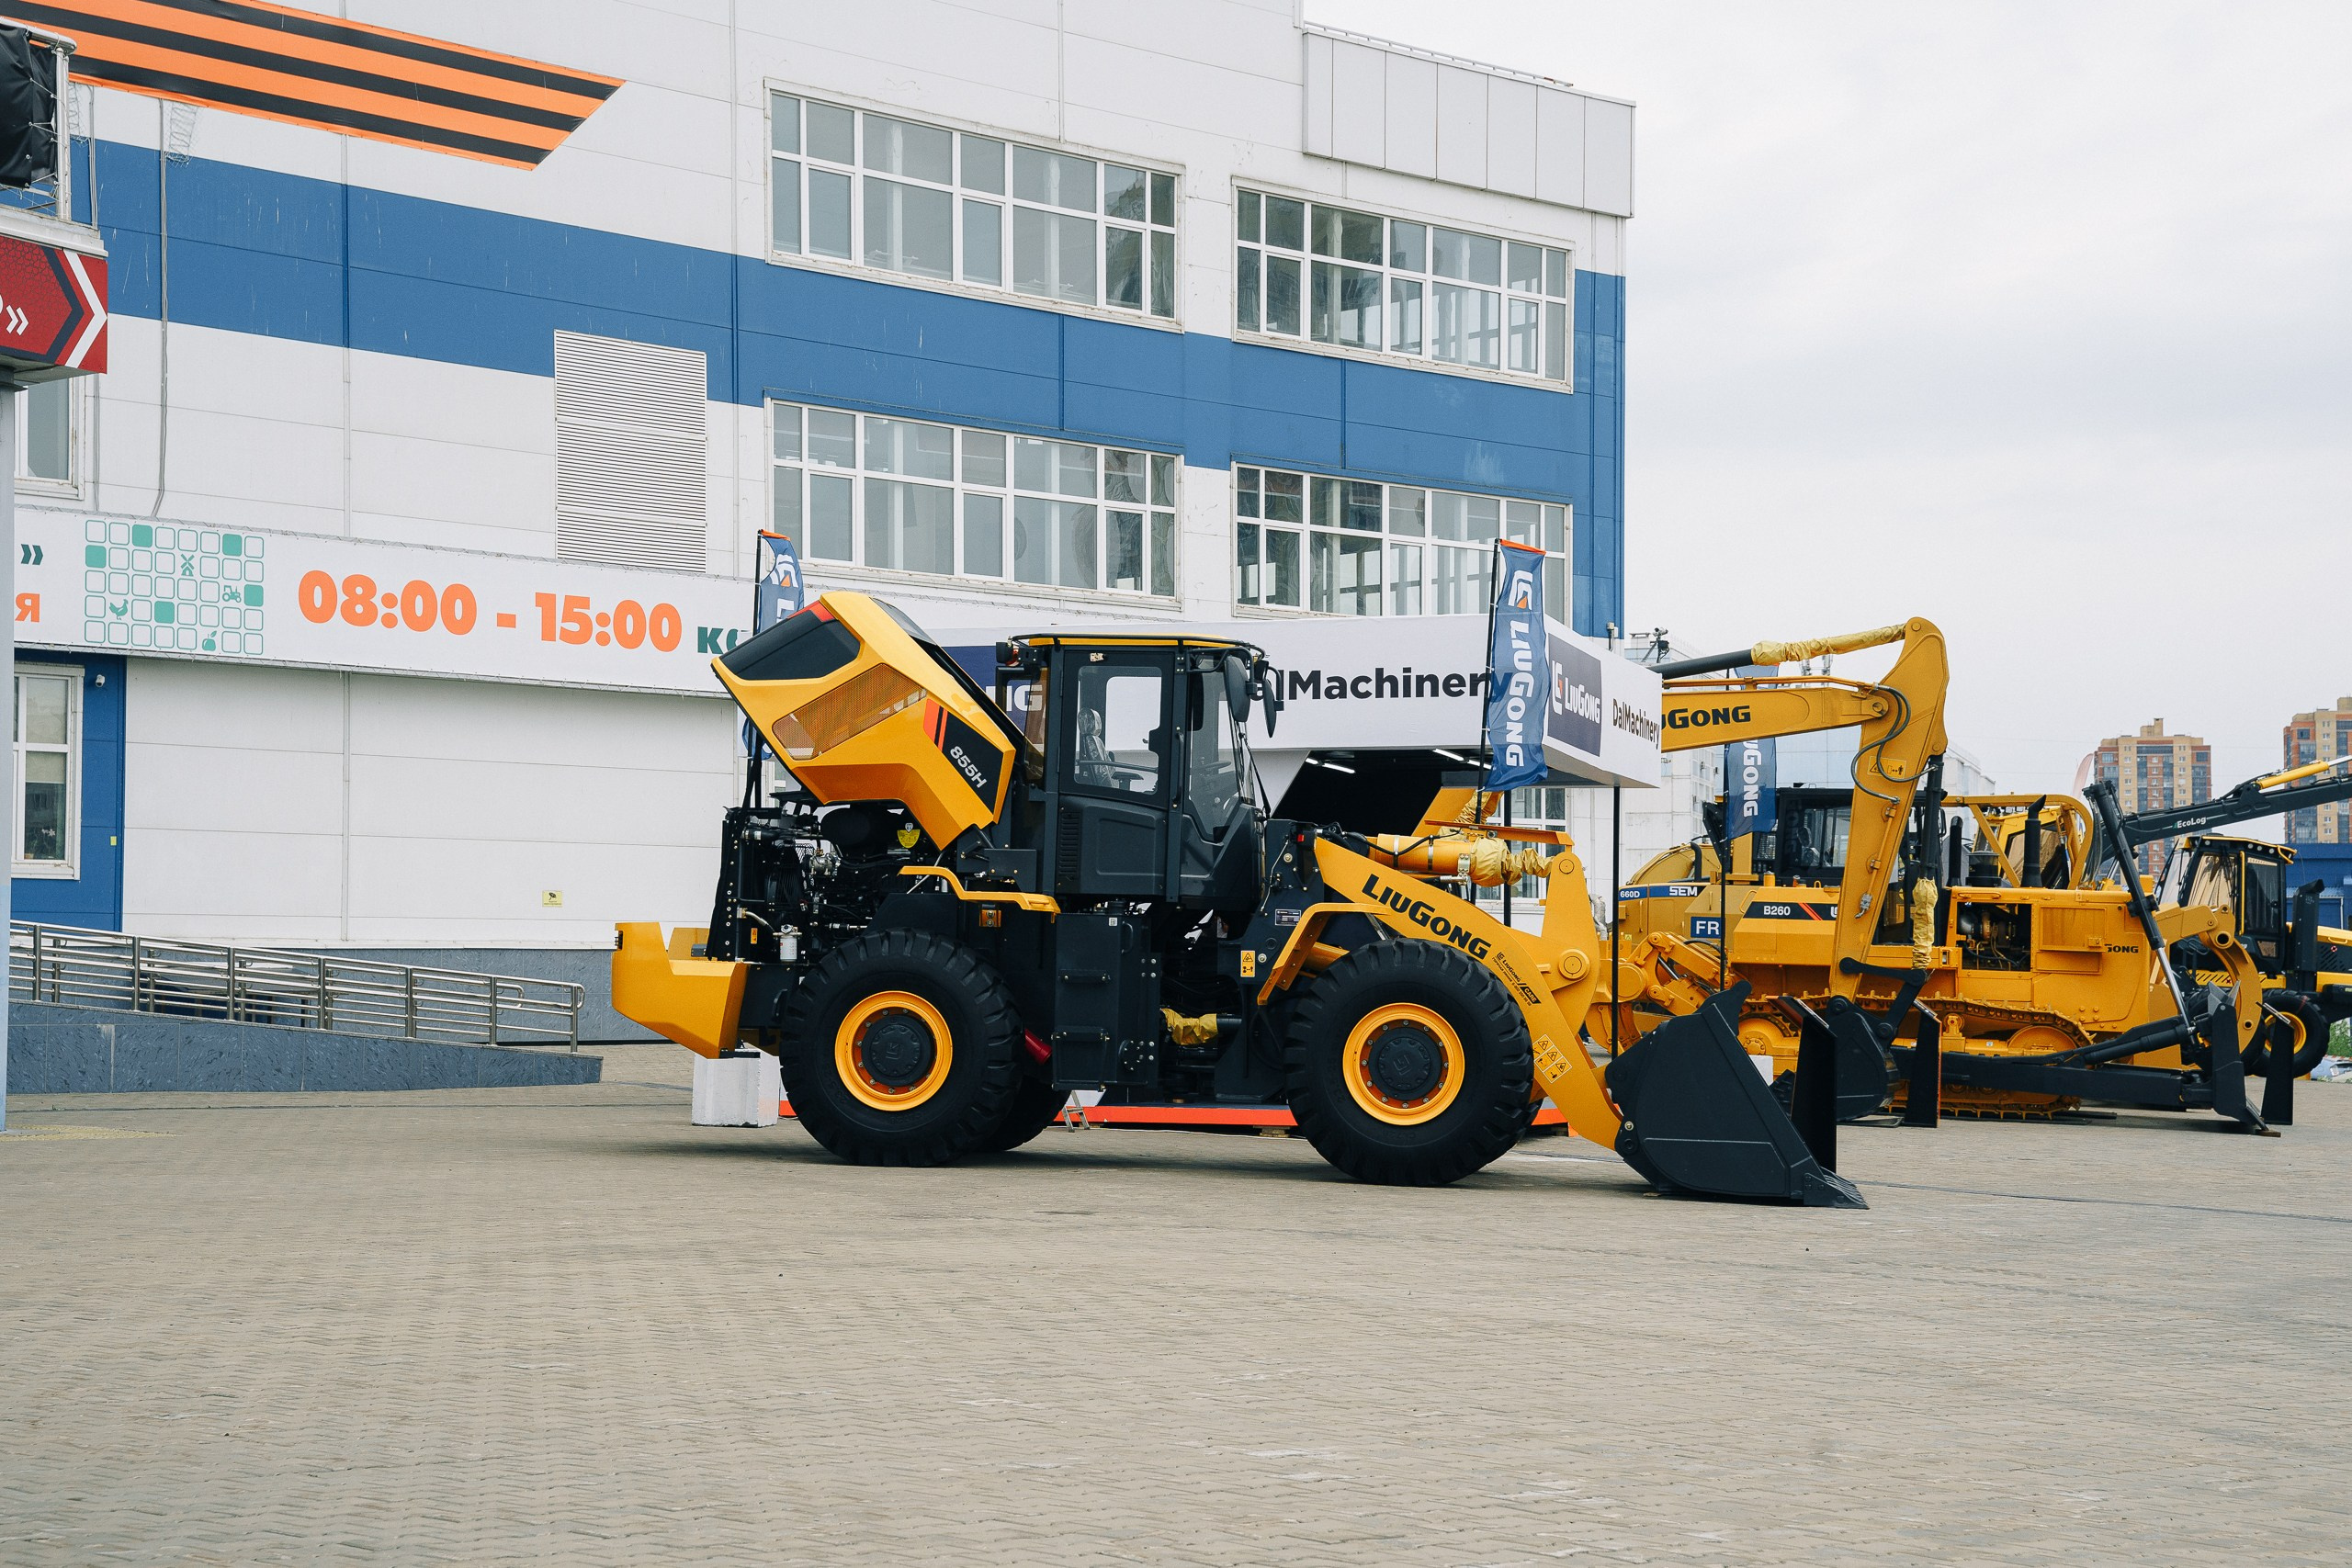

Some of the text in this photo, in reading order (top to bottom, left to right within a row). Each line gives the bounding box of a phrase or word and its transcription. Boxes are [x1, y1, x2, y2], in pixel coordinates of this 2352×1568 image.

[299, 570, 477, 636] 08:00
[497, 613, 516, 628] -
[536, 592, 682, 653] 15:00
[1612, 698, 1660, 750] DalMachinery
[950, 746, 988, 788] 855H
[2177, 817, 2207, 829] EcoLog
[1620, 890, 1640, 898] 660D
[1669, 886, 1698, 897] SEM
[1764, 905, 1791, 916] B260
[1696, 920, 1720, 935] FR
[1524, 987, 1537, 1003] CARE
